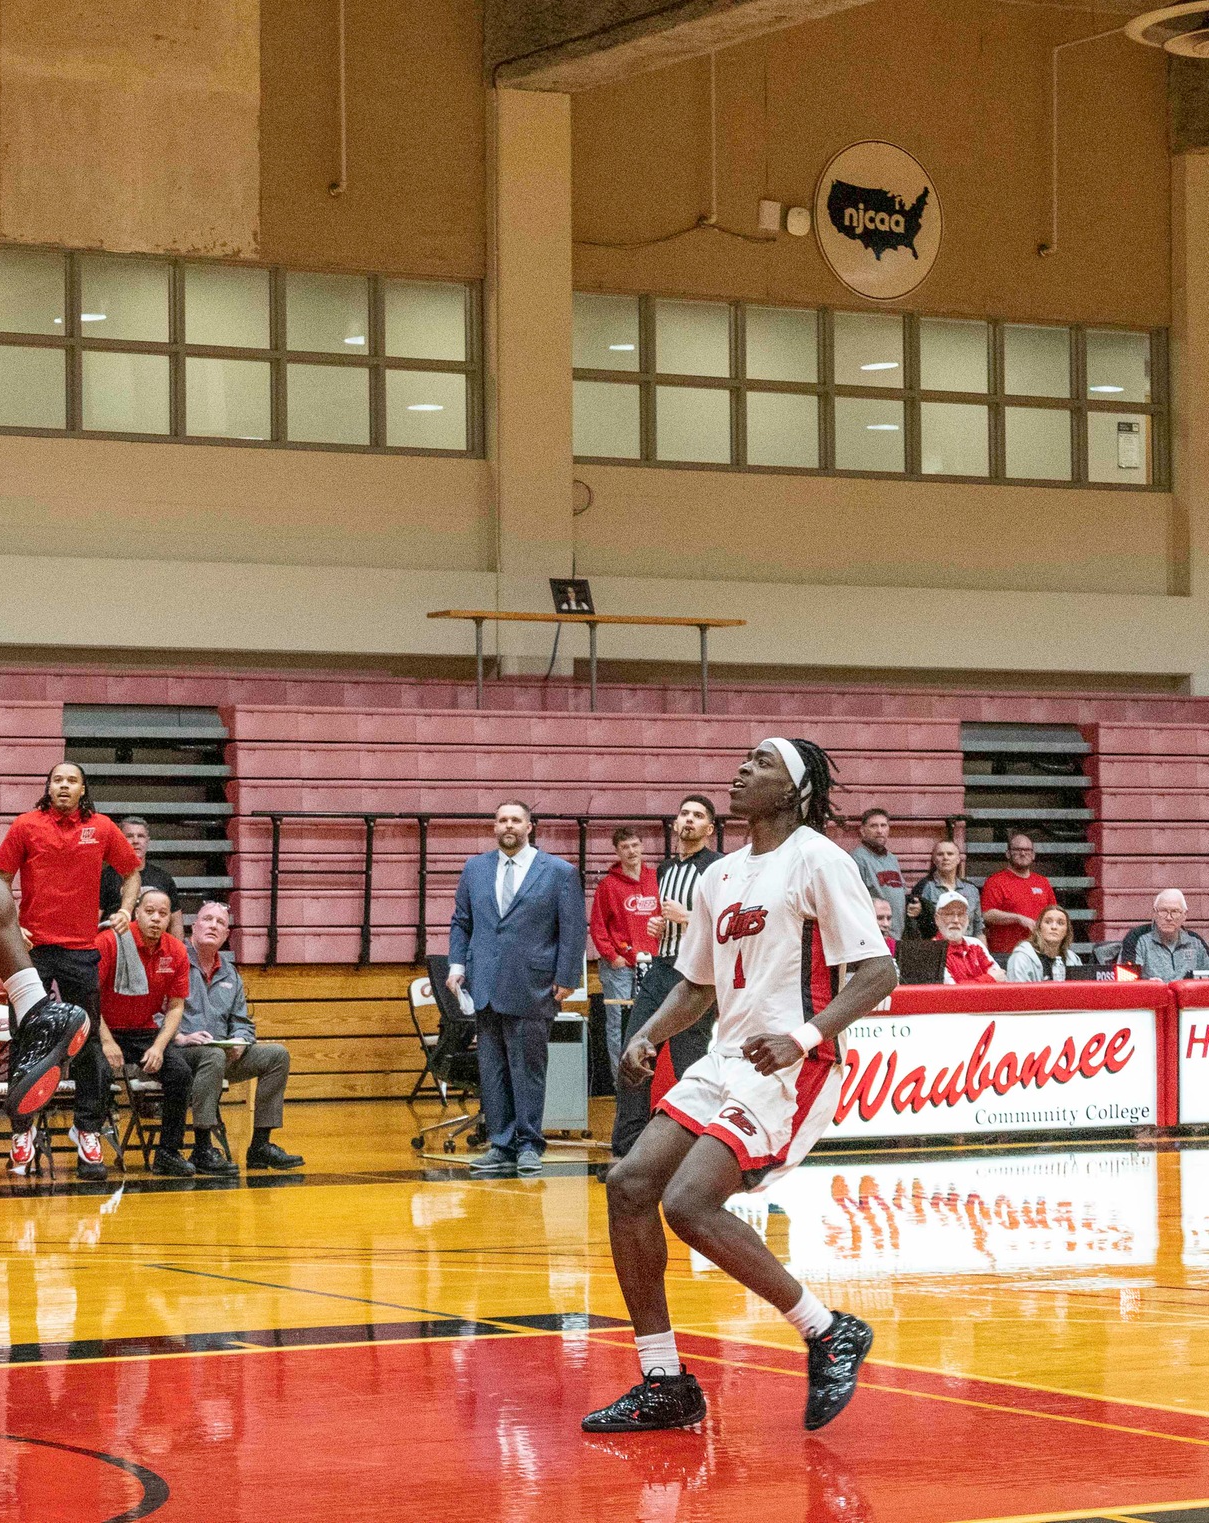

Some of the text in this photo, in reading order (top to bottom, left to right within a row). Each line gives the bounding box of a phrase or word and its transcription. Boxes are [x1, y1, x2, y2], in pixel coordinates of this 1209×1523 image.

[843, 203, 905, 234] njcaa
[733, 949, 746, 989] 1
[891, 1022, 911, 1038] to
[833, 1020, 1135, 1126] Waubonsee
[975, 1104, 1150, 1125] Community College
